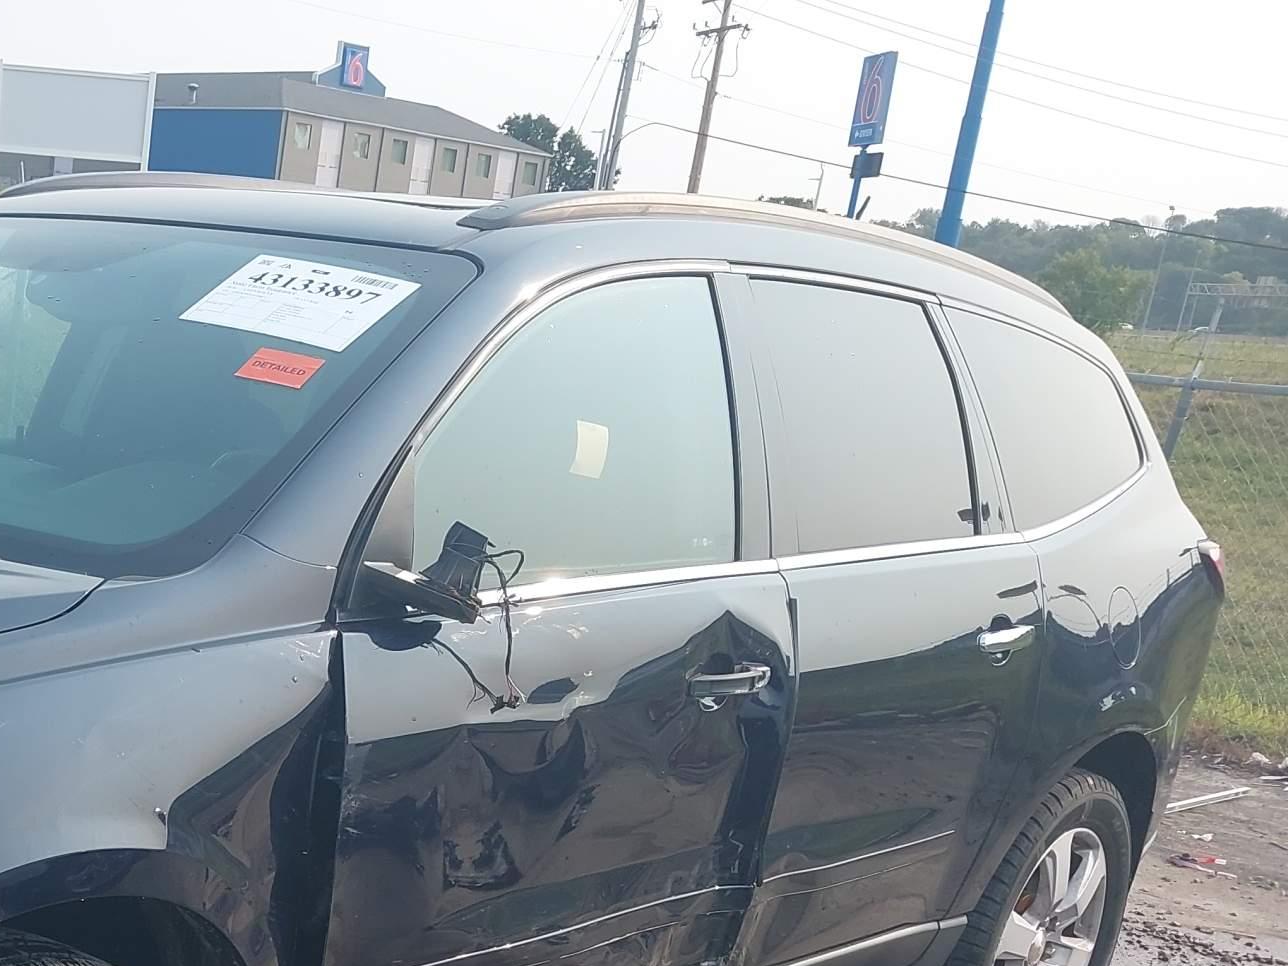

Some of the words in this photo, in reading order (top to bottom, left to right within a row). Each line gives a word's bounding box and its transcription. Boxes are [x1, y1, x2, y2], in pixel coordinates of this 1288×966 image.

[348, 53, 364, 87] 6
[861, 55, 884, 123] 6
[248, 271, 382, 305] 43133897
[251, 359, 306, 377] DETAILED
